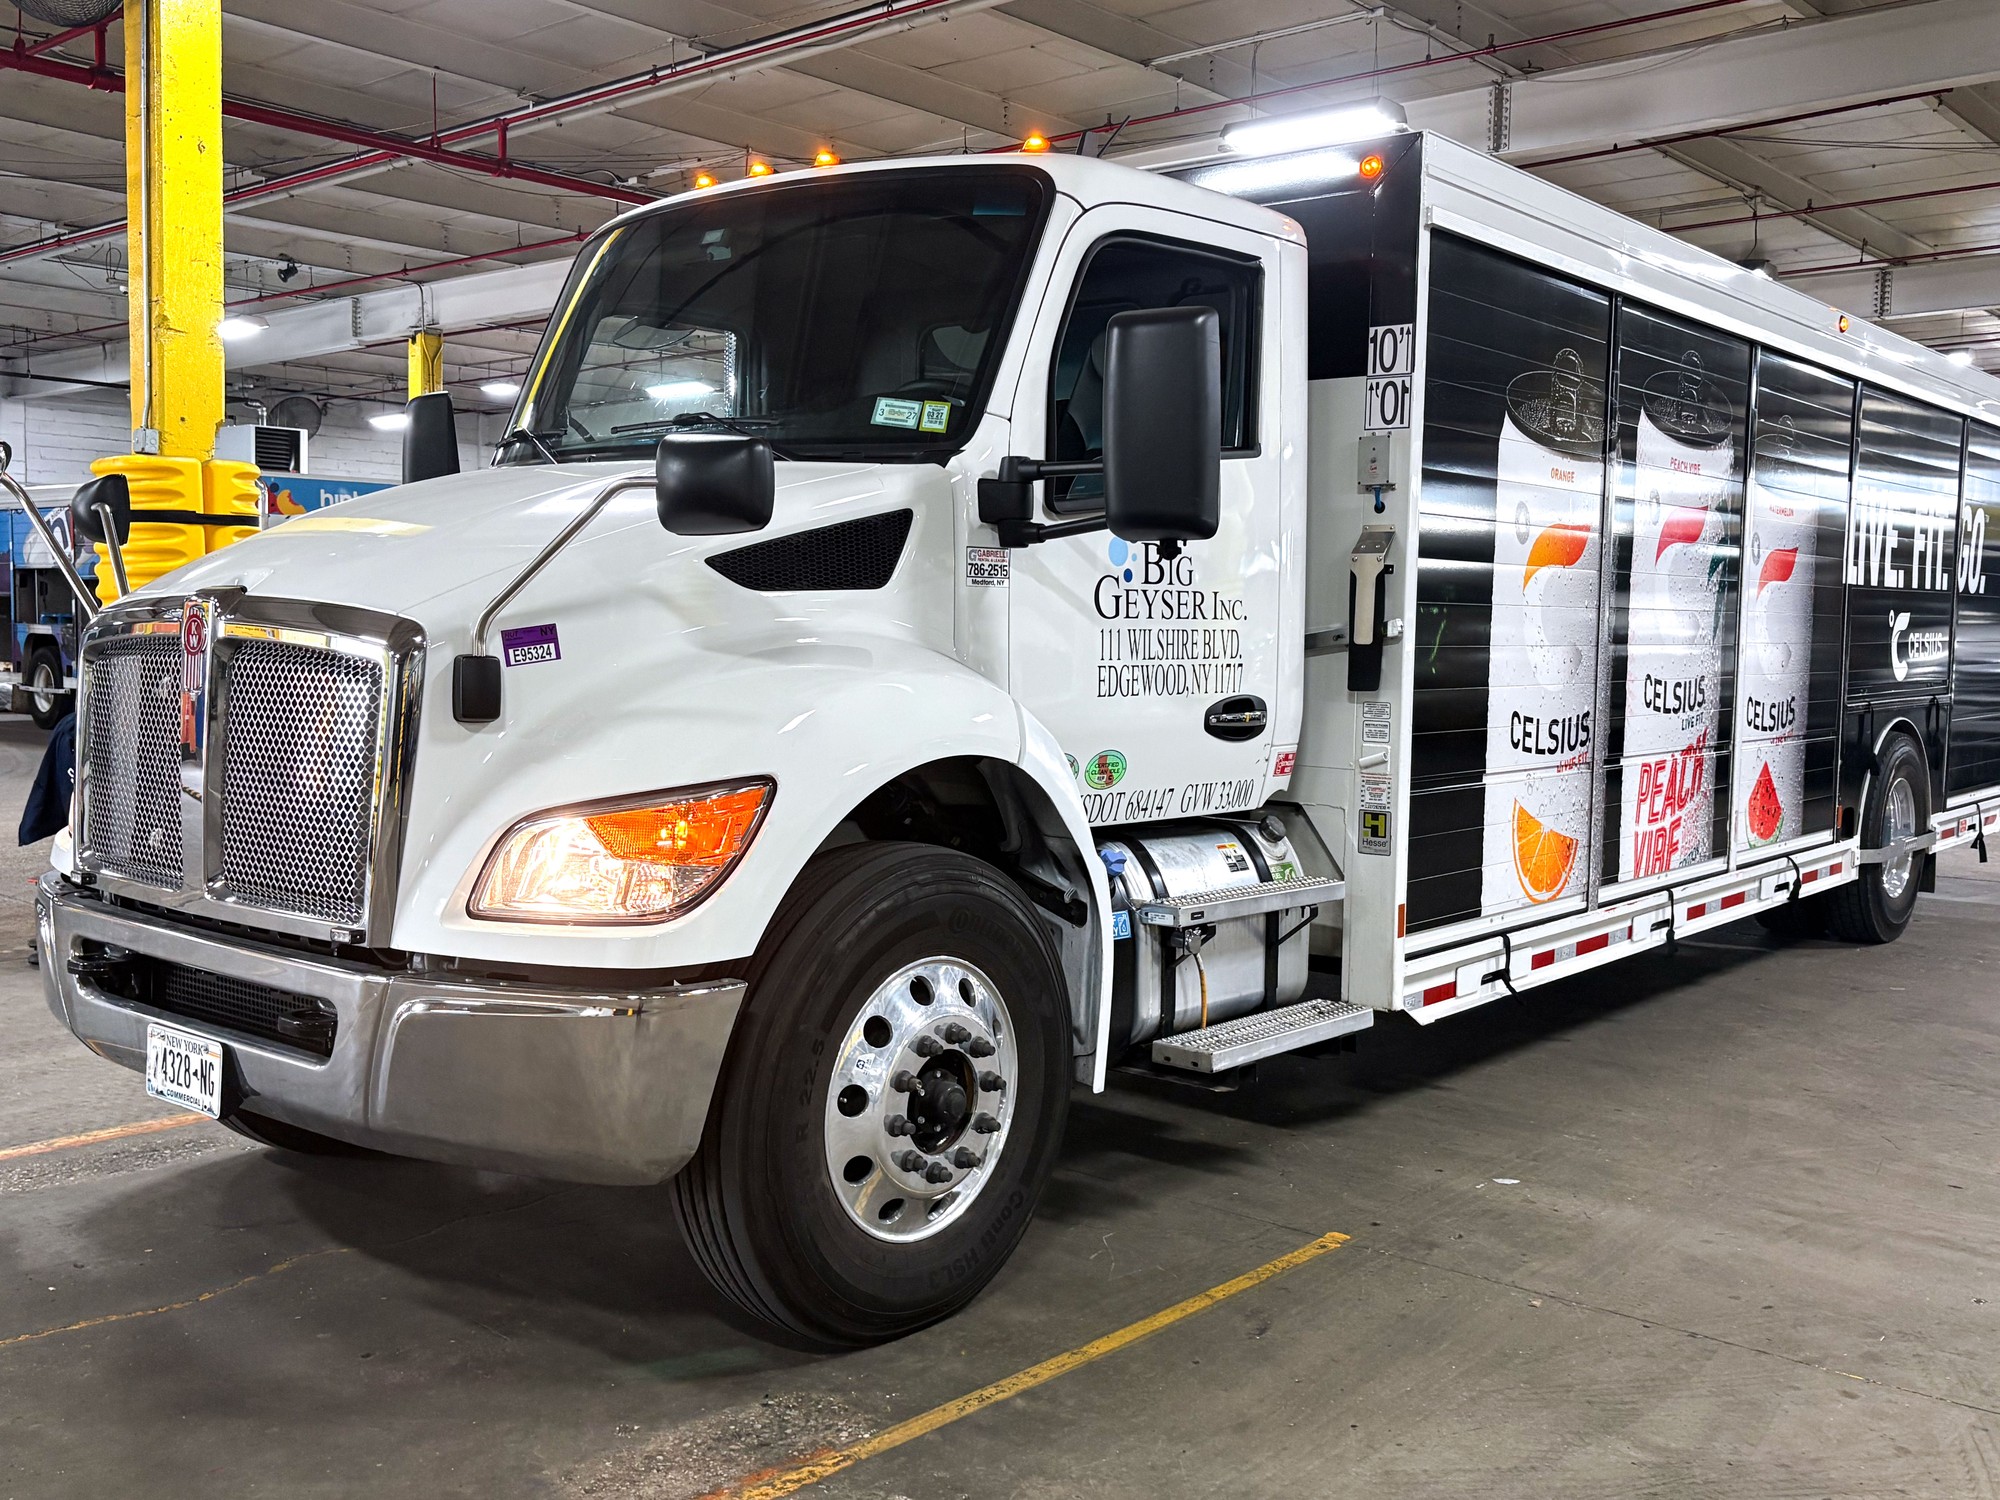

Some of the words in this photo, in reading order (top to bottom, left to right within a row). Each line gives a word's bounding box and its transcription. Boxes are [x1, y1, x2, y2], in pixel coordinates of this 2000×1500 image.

[906, 412, 917, 420] 27
[1670, 457, 1688, 471] PEACH
[1551, 468, 1574, 482] ORANGE
[320, 489, 358, 507] hi
[978, 550, 1008, 558] GABRIELLI
[968, 563, 1008, 576] 786-2515
[540, 626, 554, 636] NY
[1100, 628, 1121, 660] 111
[1128, 628, 1199, 660] WILSHIRE
[1202, 629, 1242, 660] BLVD.
[1908, 632, 1942, 658] CELSIUS
[513, 645, 552, 663] E95324
[1214, 664, 1243, 694] 11717
[1644, 674, 1705, 714] CELSIUS
[1682, 716, 1694, 730] LIVE
[1746, 696, 1795, 732] CELSIUS
[1510, 710, 1590, 755] CELSIUS
[1635, 727, 1708, 825] PEACH
[1080, 792, 1126, 823] SDOT
[1125, 788, 1174, 820] 684147
[1180, 782, 1218, 813] GVW
[1215, 778, 1254, 811] 33,000
[1362, 838, 1387, 847] Hesse
[166, 1034, 182, 1050] NEW
[184, 1040, 204, 1056] YORK
[166, 1088, 200, 1106] COMMERCIAL
